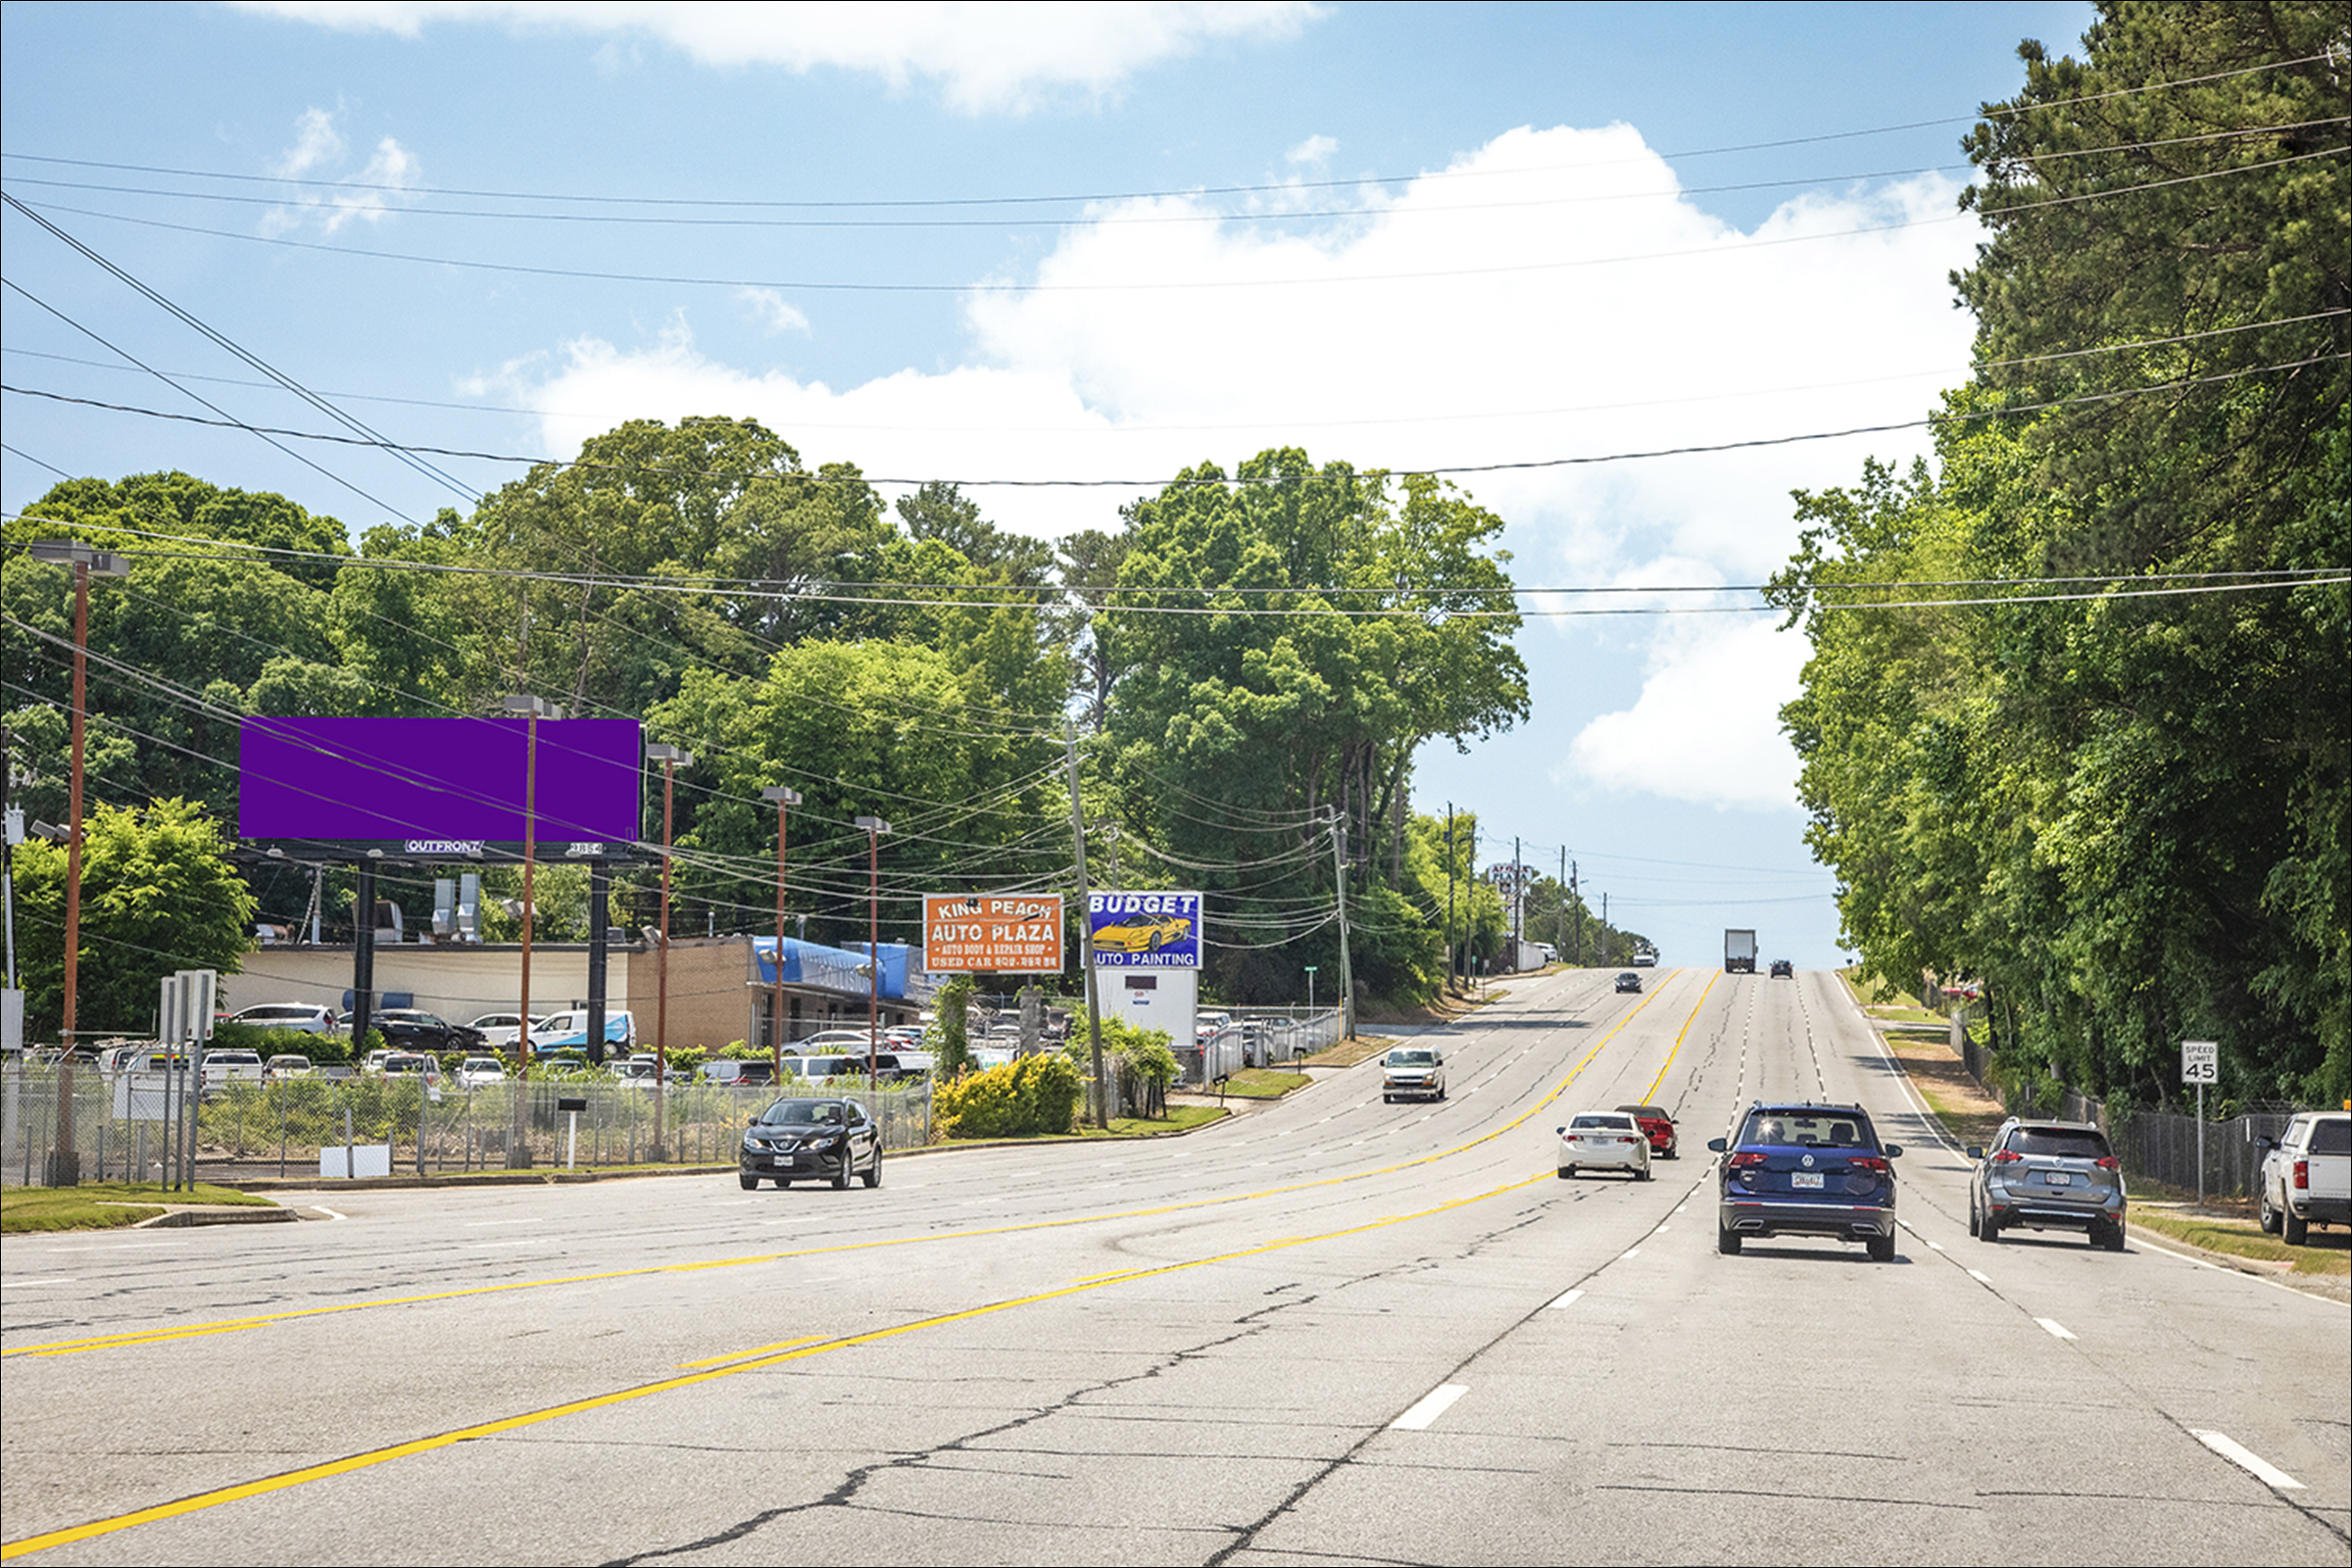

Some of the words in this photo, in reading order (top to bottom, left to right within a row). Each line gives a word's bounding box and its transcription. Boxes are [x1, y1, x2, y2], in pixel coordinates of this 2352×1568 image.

[408, 840, 480, 852] OUTFRONT
[938, 900, 983, 919] KING
[991, 900, 1053, 920] PEACH
[1090, 896, 1196, 913] BUDGET
[931, 924, 983, 942] AUTO
[992, 924, 1055, 942] PLAZA
[942, 944, 962, 955] AUTO
[964, 944, 983, 955] BODY
[994, 944, 1023, 955] REPAIR
[1025, 944, 1046, 955] SHOP
[931, 956, 963, 967] USED
[967, 956, 992, 967] CAR
[1095, 954, 1124, 965] UTO
[1131, 954, 1195, 965] PAINTING
[2185, 1045, 2215, 1054] SPEED
[2185, 1063, 2215, 1079] 45
